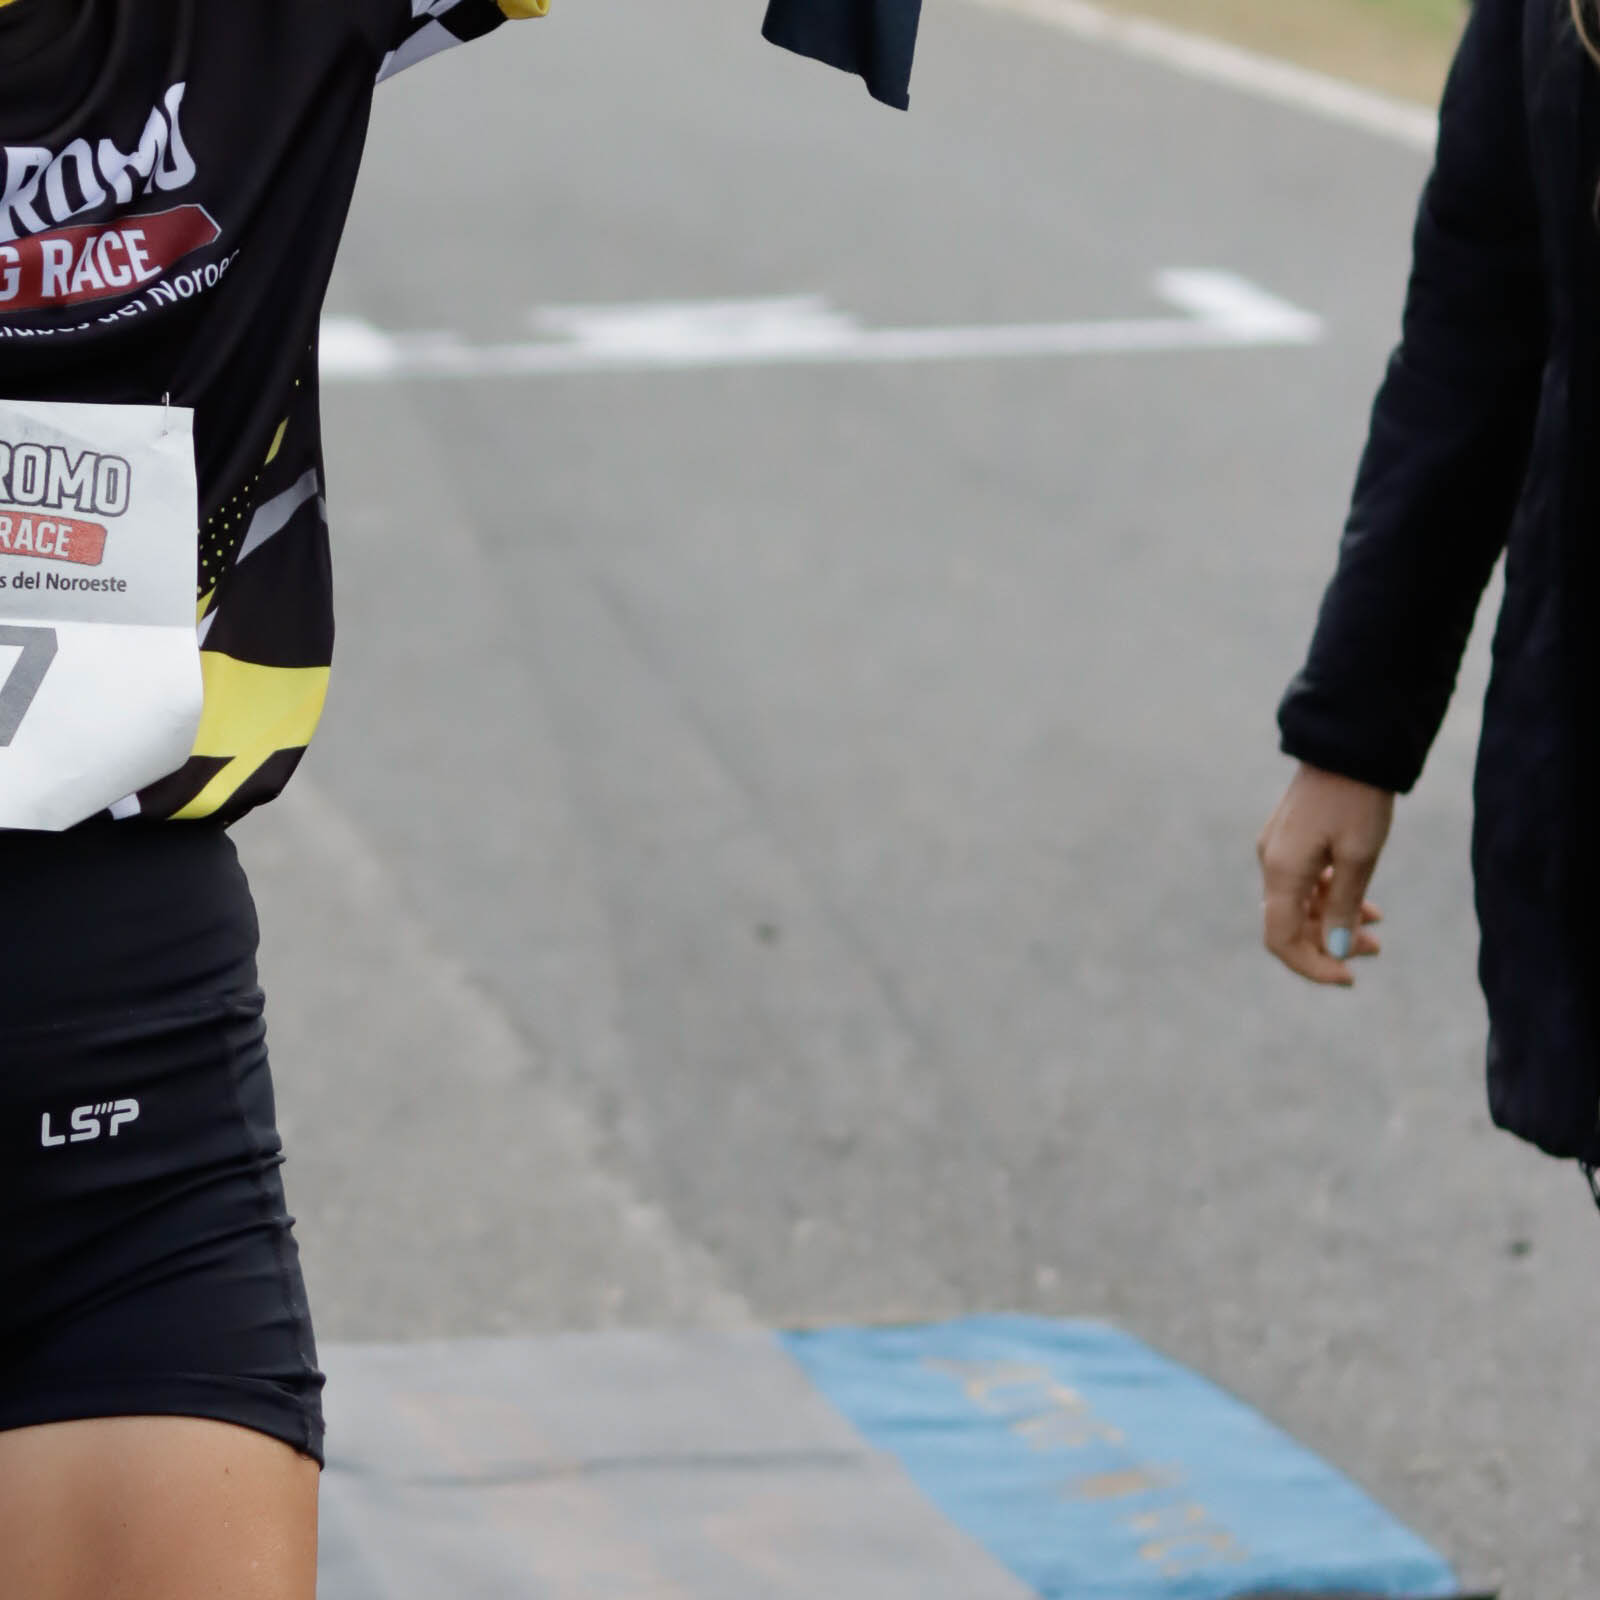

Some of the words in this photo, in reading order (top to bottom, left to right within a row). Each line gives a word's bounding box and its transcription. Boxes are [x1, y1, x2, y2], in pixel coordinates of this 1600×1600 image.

[40, 229, 163, 299] RACE
[12, 571, 41, 590] del
[46, 573, 128, 593] Noroeste
[41, 1098, 140, 1147] LSP
